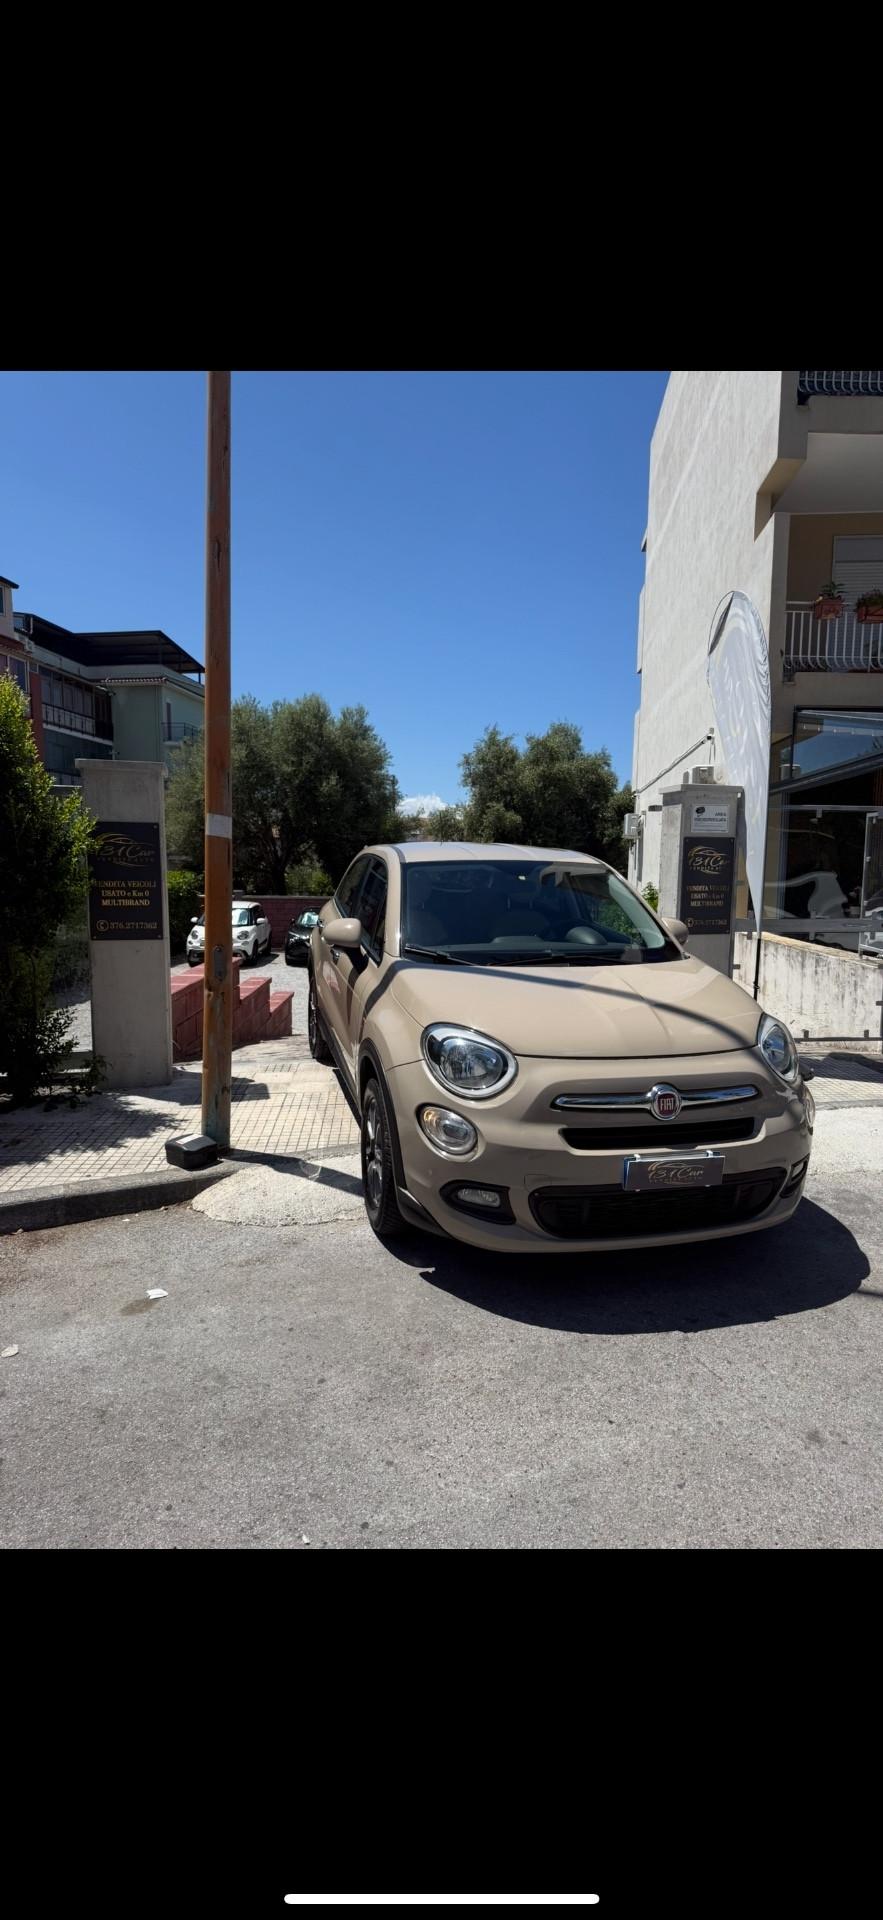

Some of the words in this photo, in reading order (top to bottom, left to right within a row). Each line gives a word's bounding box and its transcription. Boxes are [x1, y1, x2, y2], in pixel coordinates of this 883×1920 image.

[101, 889, 126, 897] USATO
[132, 889, 144, 897] Km
[660, 1097, 674, 1111] FIAT
